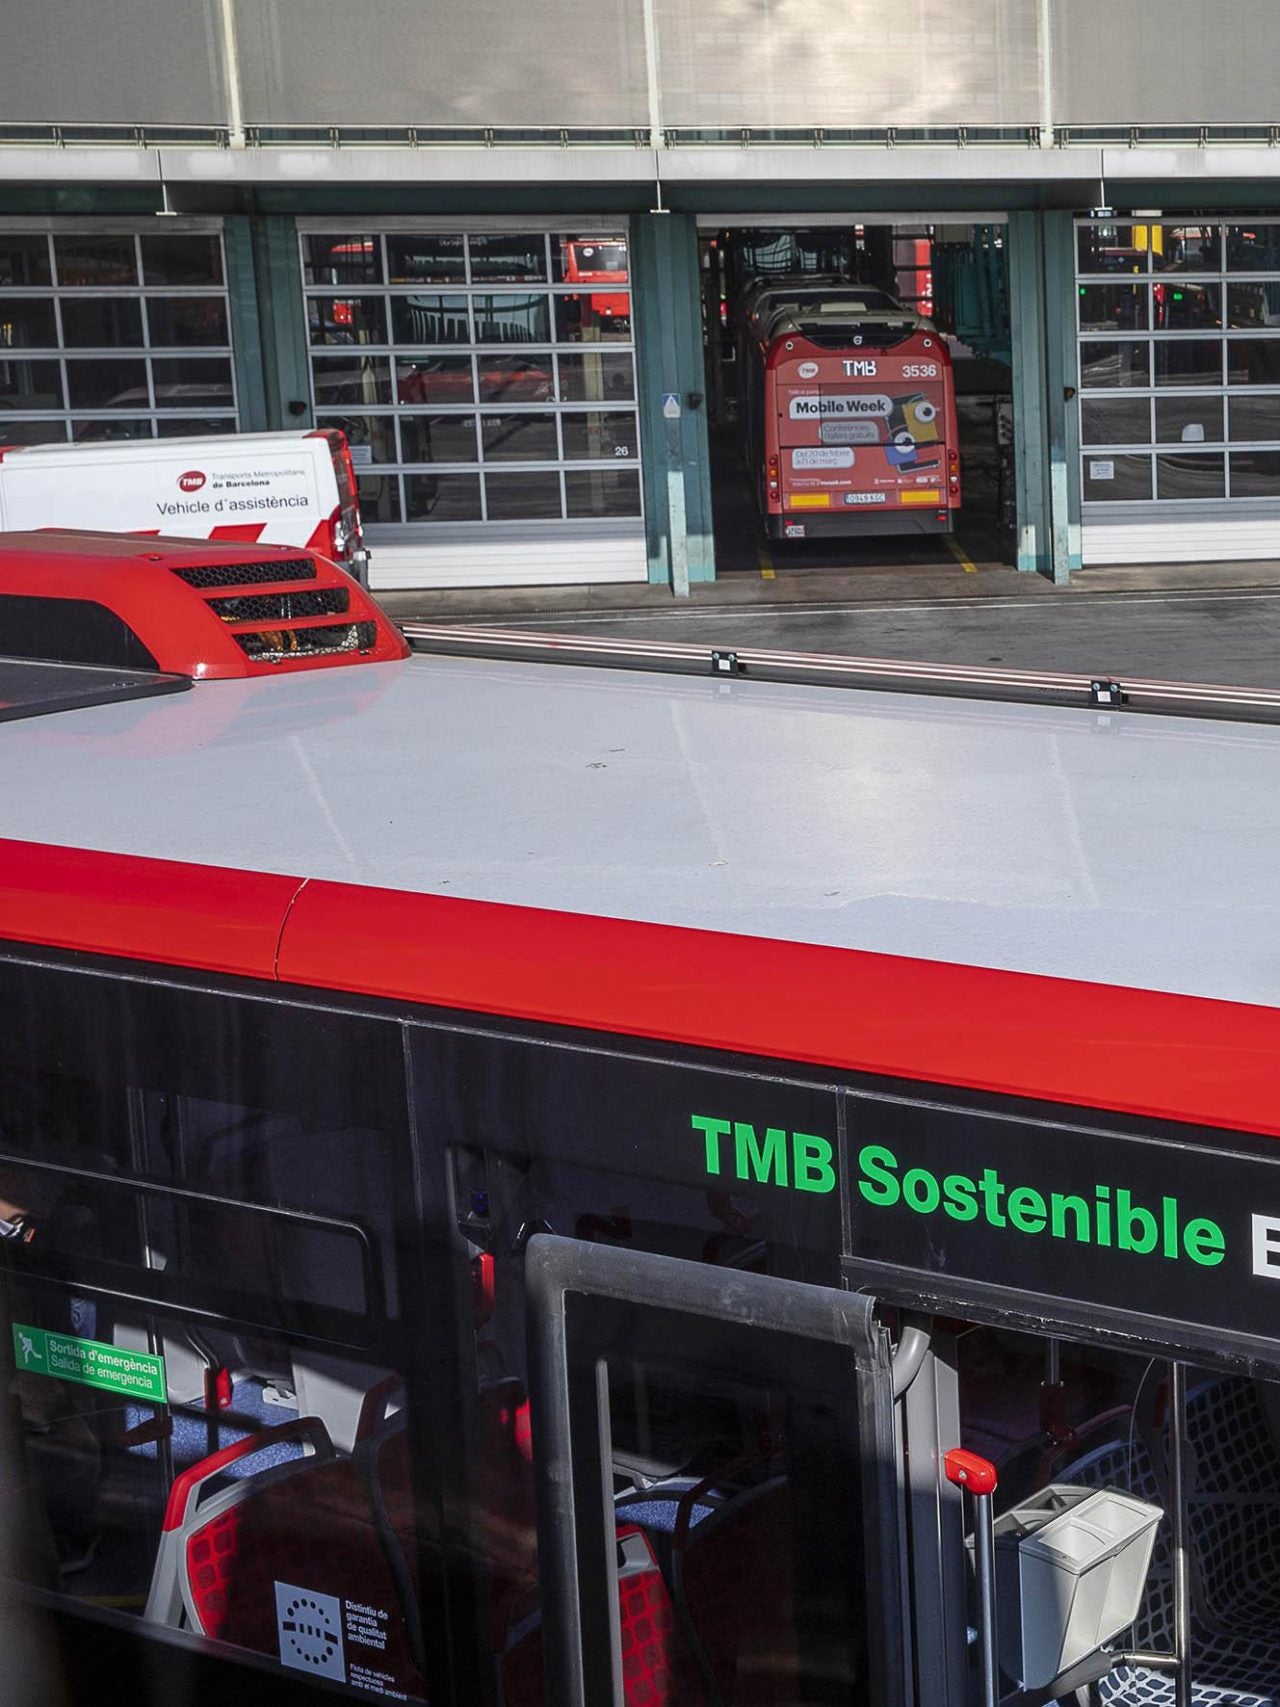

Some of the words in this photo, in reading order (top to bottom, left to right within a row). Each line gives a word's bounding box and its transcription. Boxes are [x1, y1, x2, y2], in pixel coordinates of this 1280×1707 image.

[842, 360, 877, 377] TMB
[902, 365, 937, 378] 3536
[796, 402, 844, 414] Mobile
[846, 400, 886, 412] Week
[615, 446, 629, 456] 26
[182, 478, 202, 487] TMB
[226, 480, 270, 488] Barcelona
[157, 502, 210, 515] Vehicle
[691, 1115, 836, 1194] TMB
[858, 1144, 1226, 1266] Sostenible
[50, 1340, 86, 1358] Sortida
[88, 1350, 157, 1375] d'emergència
[51, 1356, 81, 1372] Salida
[82, 1363, 95, 1374] de
[97, 1367, 153, 1389] emergencia
[345, 1600, 376, 1617] Distintiu
[378, 1610, 388, 1620] de
[346, 1612, 377, 1627] garantia
[347, 1622, 357, 1631] de
[358, 1624, 387, 1641] qualitat
[348, 1632, 385, 1650] ambiental
